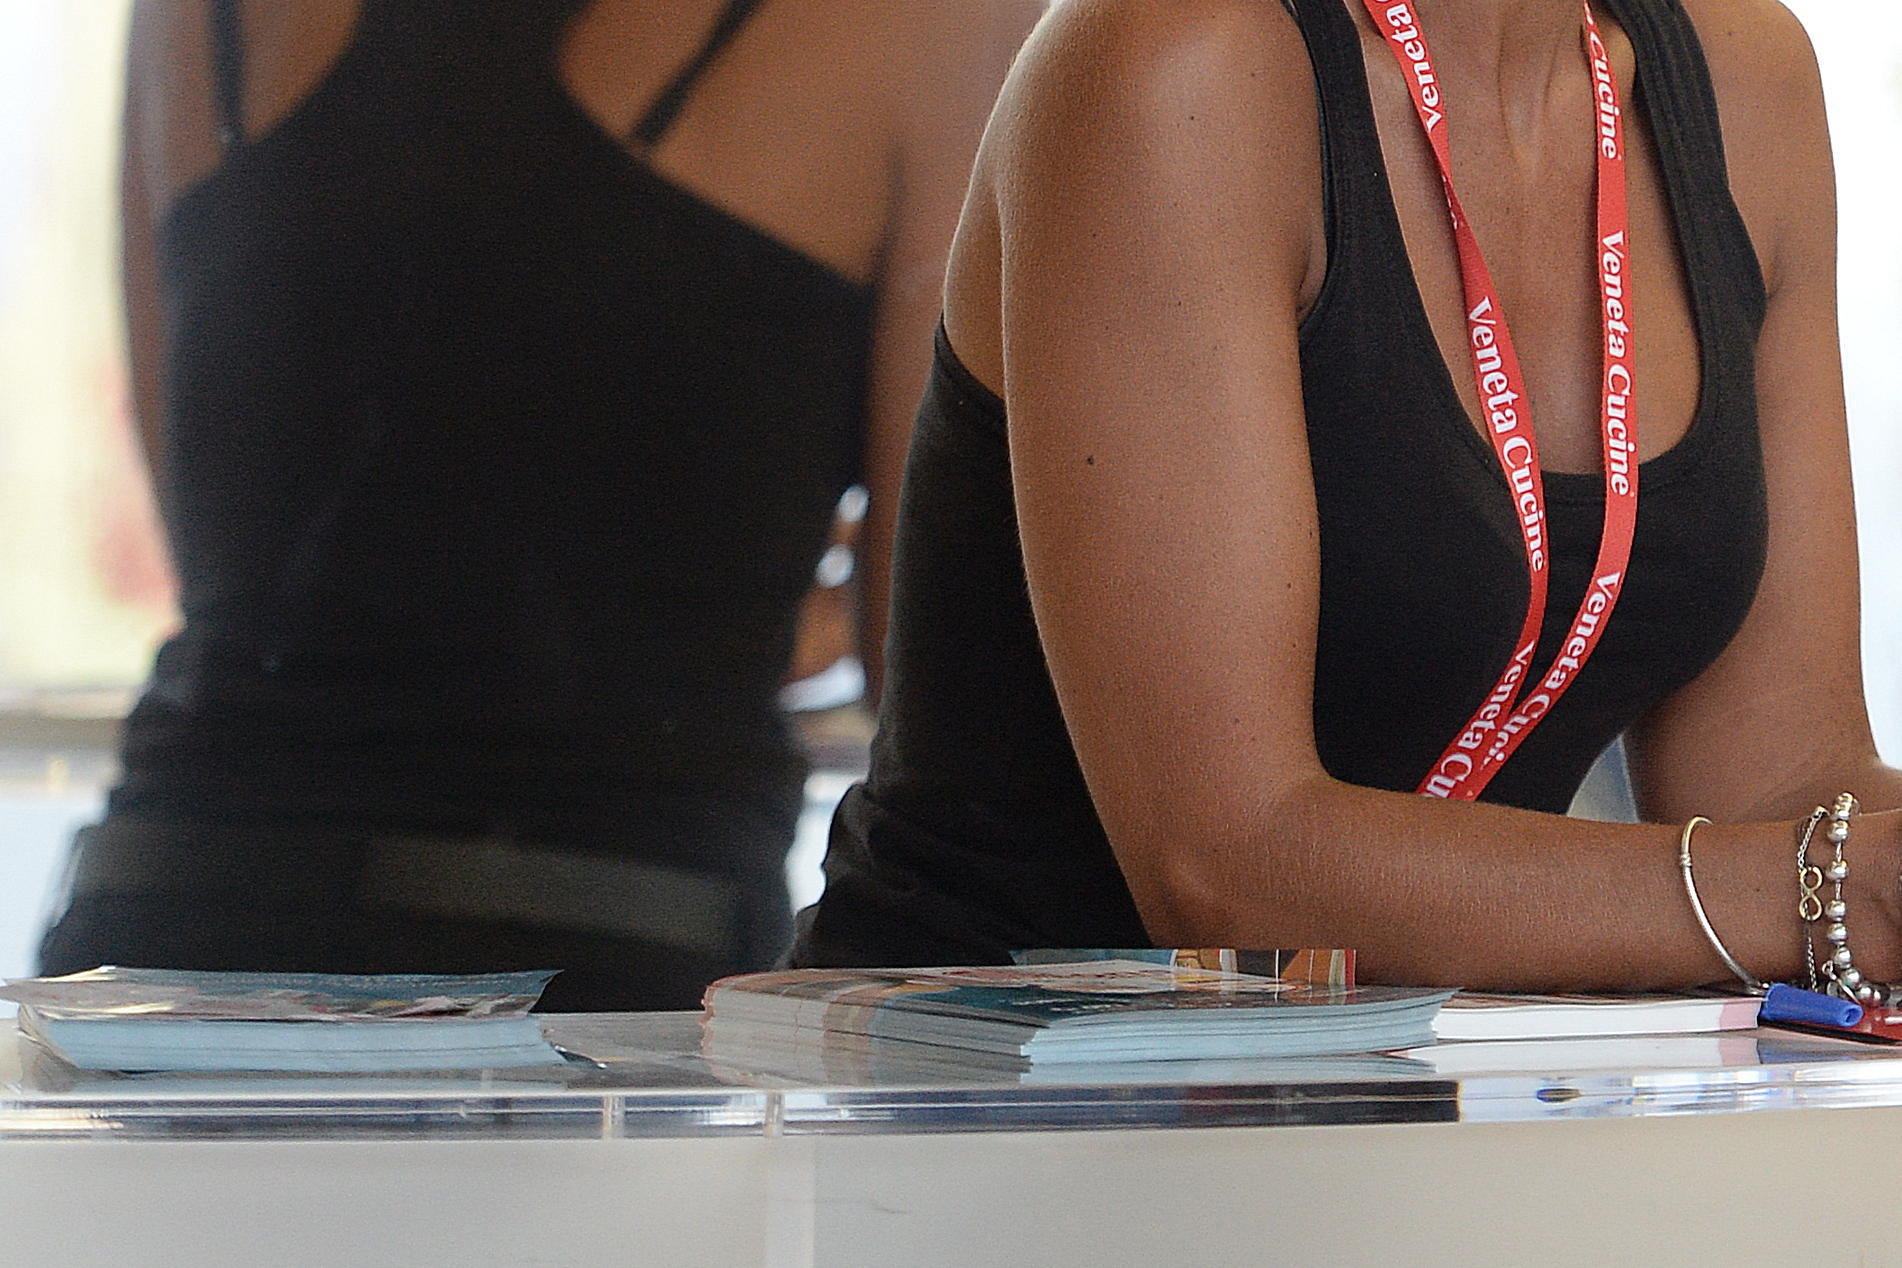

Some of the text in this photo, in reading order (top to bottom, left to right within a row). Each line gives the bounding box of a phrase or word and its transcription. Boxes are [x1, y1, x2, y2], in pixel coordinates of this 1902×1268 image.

[1386, 3, 1443, 131] Veneta
[1590, 32, 1620, 160] Cucine
[1602, 230, 1636, 495] Veneta Cucine
[1468, 296, 1544, 572] Veneta Cucine
[1545, 571, 1621, 689] Veneta
[1457, 640, 1536, 749] Veneta
